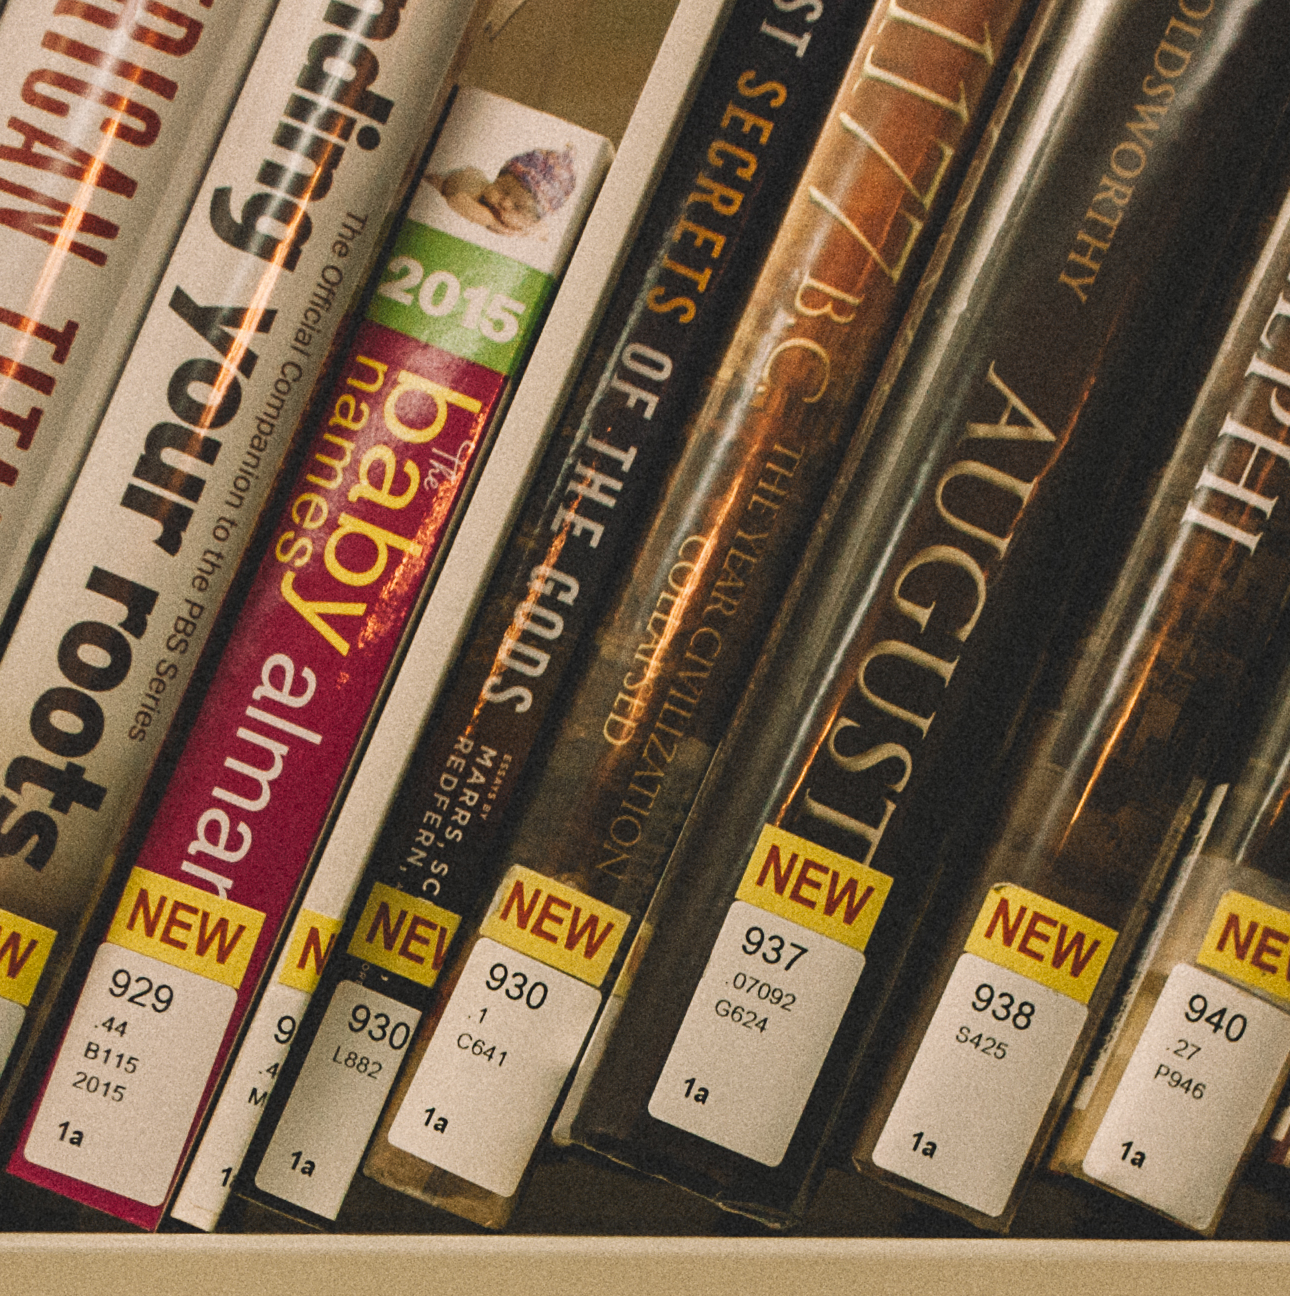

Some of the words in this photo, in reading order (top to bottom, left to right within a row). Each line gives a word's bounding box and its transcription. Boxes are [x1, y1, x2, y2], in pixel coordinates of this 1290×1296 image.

[649, 68, 789, 325] SECRETS
[332, 210, 368, 264] The
[299, 265, 343, 344] Official
[380, 256, 526, 343] 2015
[621, 341, 675, 420] OF
[120, 284, 278, 558] your
[234, 347, 304, 507] Companion
[275, 354, 389, 569] names
[551, 434, 639, 549] THE
[210, 516, 239, 542] to
[280, 369, 483, 657] baby
[189, 547, 225, 596] the
[159, 593, 206, 655] PBS
[481, 563, 581, 715] GODS
[805, 361, 1058, 868] AUGUST
[126, 657, 178, 744] Series
[437, 744, 498, 848] MARRS,
[499, 879, 615, 960] NEW
[757, 842, 874, 926] NEW
[126, 889, 247, 965] NEW
[741, 925, 808, 972] 937
[985, 897, 1101, 978] NEW
[107, 967, 176, 1014] 929
[484, 962, 549, 1010] 930
[713, 1000, 769, 1035] G624
[971, 984, 1036, 1031] 938
[1184, 994, 1248, 1043] 940
[83, 1042, 139, 1076] B115
[347, 1003, 411, 1051] 930
[456, 1031, 509, 1067] C641
[955, 1025, 1009, 1060] S425
[72, 1070, 126, 1103] 2015
[1155, 1063, 1206, 1100] P946
